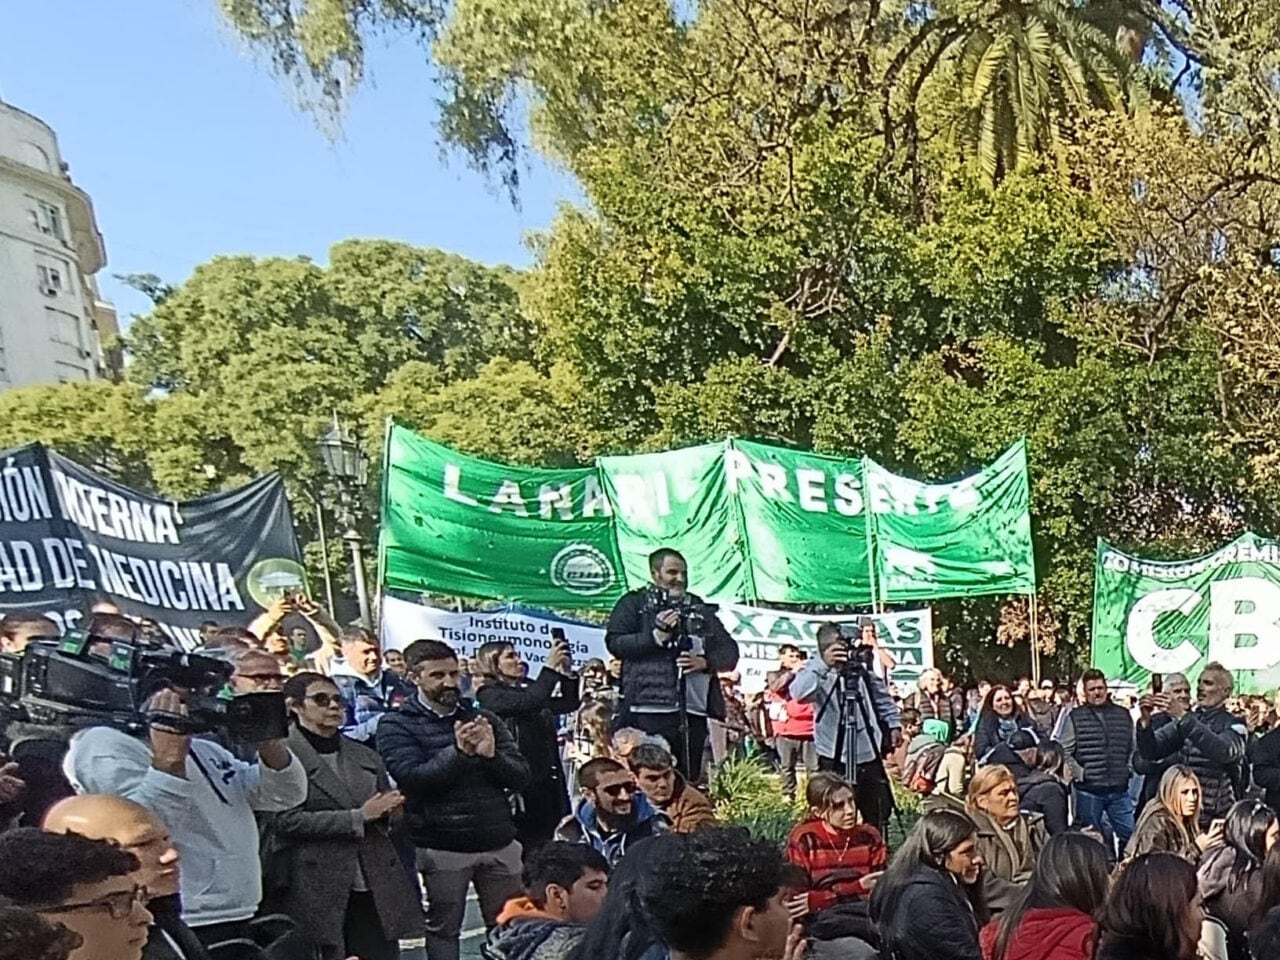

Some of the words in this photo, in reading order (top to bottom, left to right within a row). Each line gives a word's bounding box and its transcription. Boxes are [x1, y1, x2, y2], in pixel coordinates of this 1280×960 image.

[0, 456, 53, 522] IÓN
[443, 462, 672, 521] LANARI
[43, 536, 96, 590] DE
[88, 544, 246, 612] MEDICINA
[469, 616, 536, 633] Instituto
